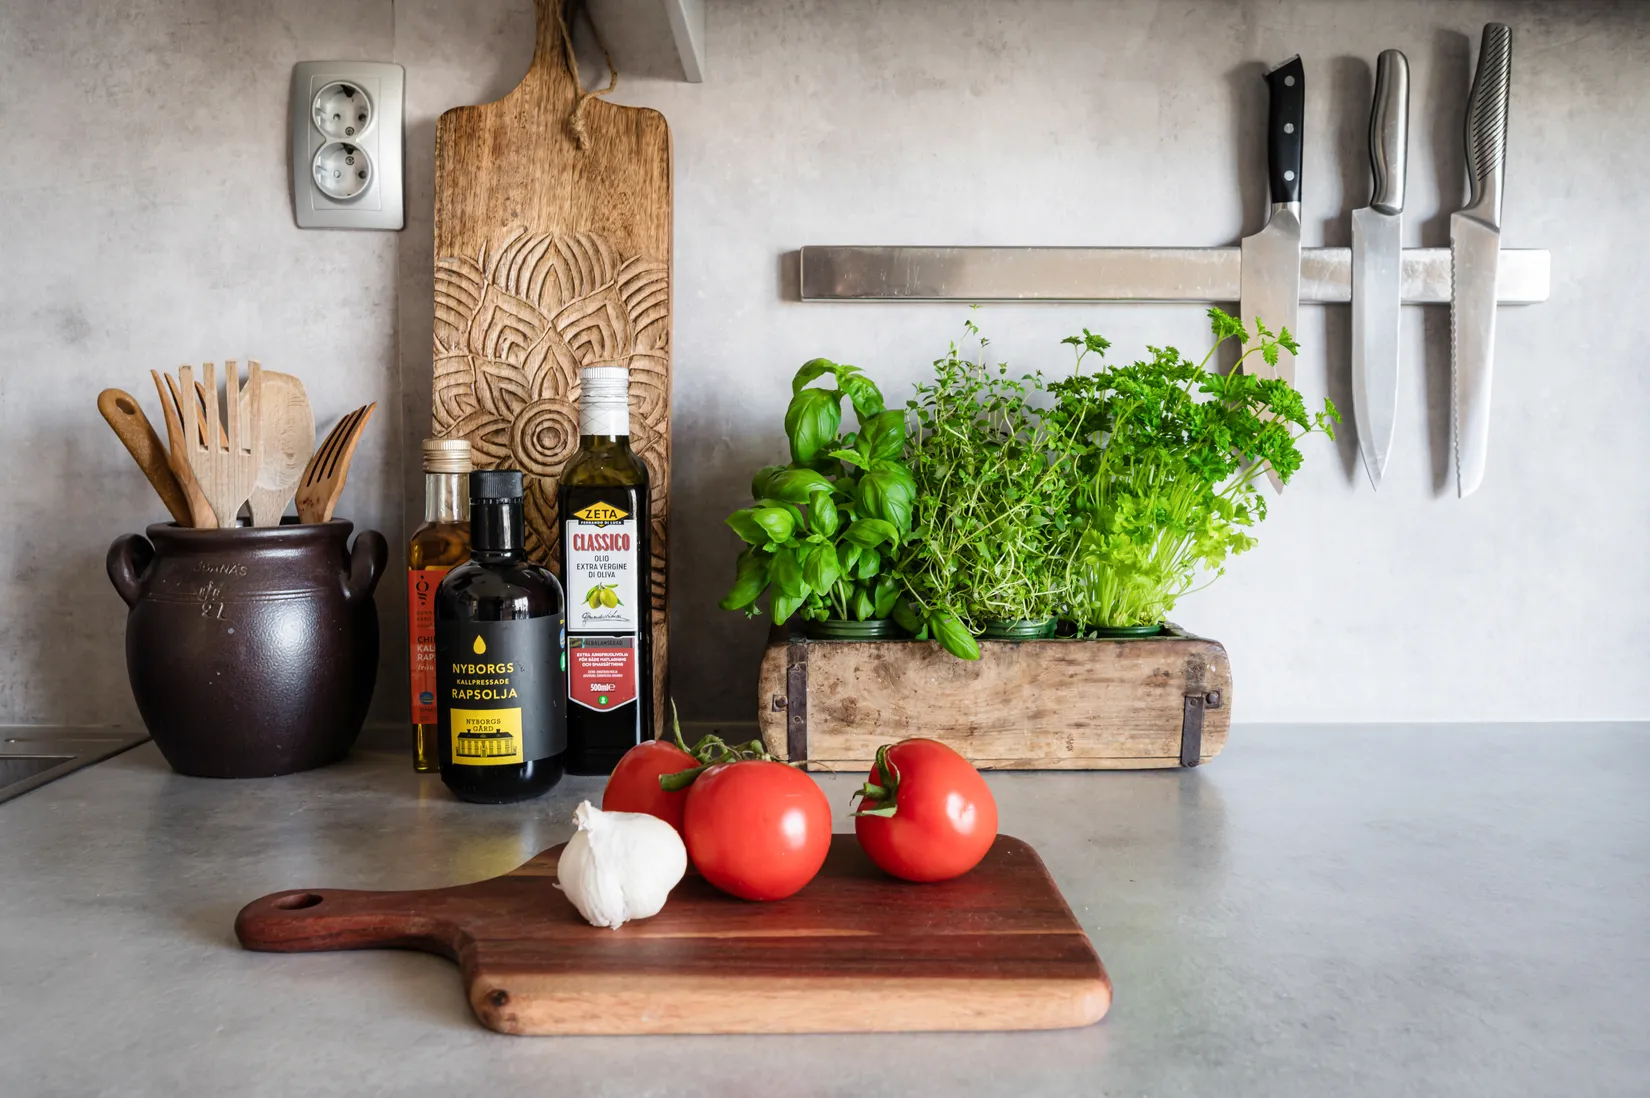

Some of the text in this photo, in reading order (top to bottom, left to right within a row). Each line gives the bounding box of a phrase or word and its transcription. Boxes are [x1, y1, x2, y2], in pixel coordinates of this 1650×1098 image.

[585, 510, 618, 518] ZETA
[573, 533, 630, 551] CLASSICO
[452, 662, 514, 674] NYBORGS
[452, 688, 518, 700] RAPSOLJA
